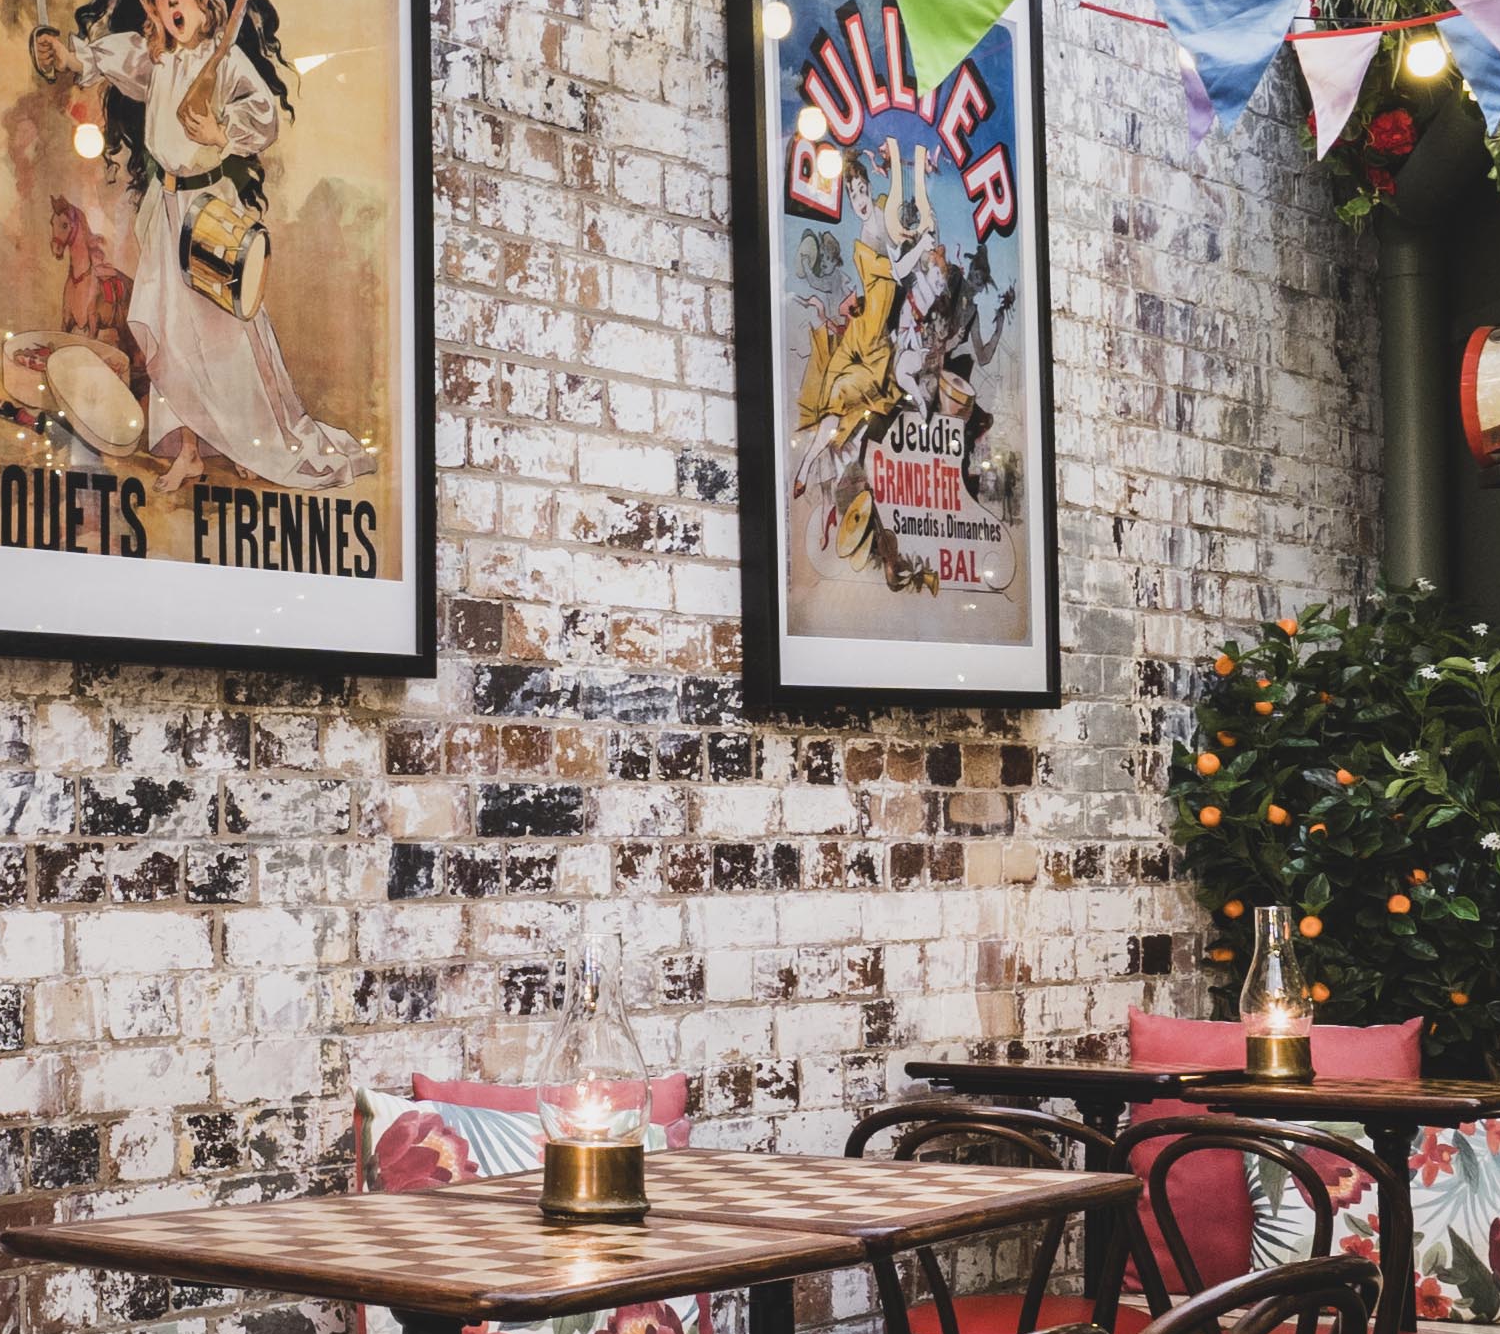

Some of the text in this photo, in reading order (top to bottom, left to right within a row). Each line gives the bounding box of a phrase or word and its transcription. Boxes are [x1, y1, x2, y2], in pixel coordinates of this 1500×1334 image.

[890, 415, 963, 457] Jeudis
[873, 450, 932, 508] GRANDE
[193, 474, 378, 580] ÉTRENNES
[893, 509, 939, 538] Samedis
[947, 514, 1002, 542] Dimanches
[939, 548, 982, 584] BAL
